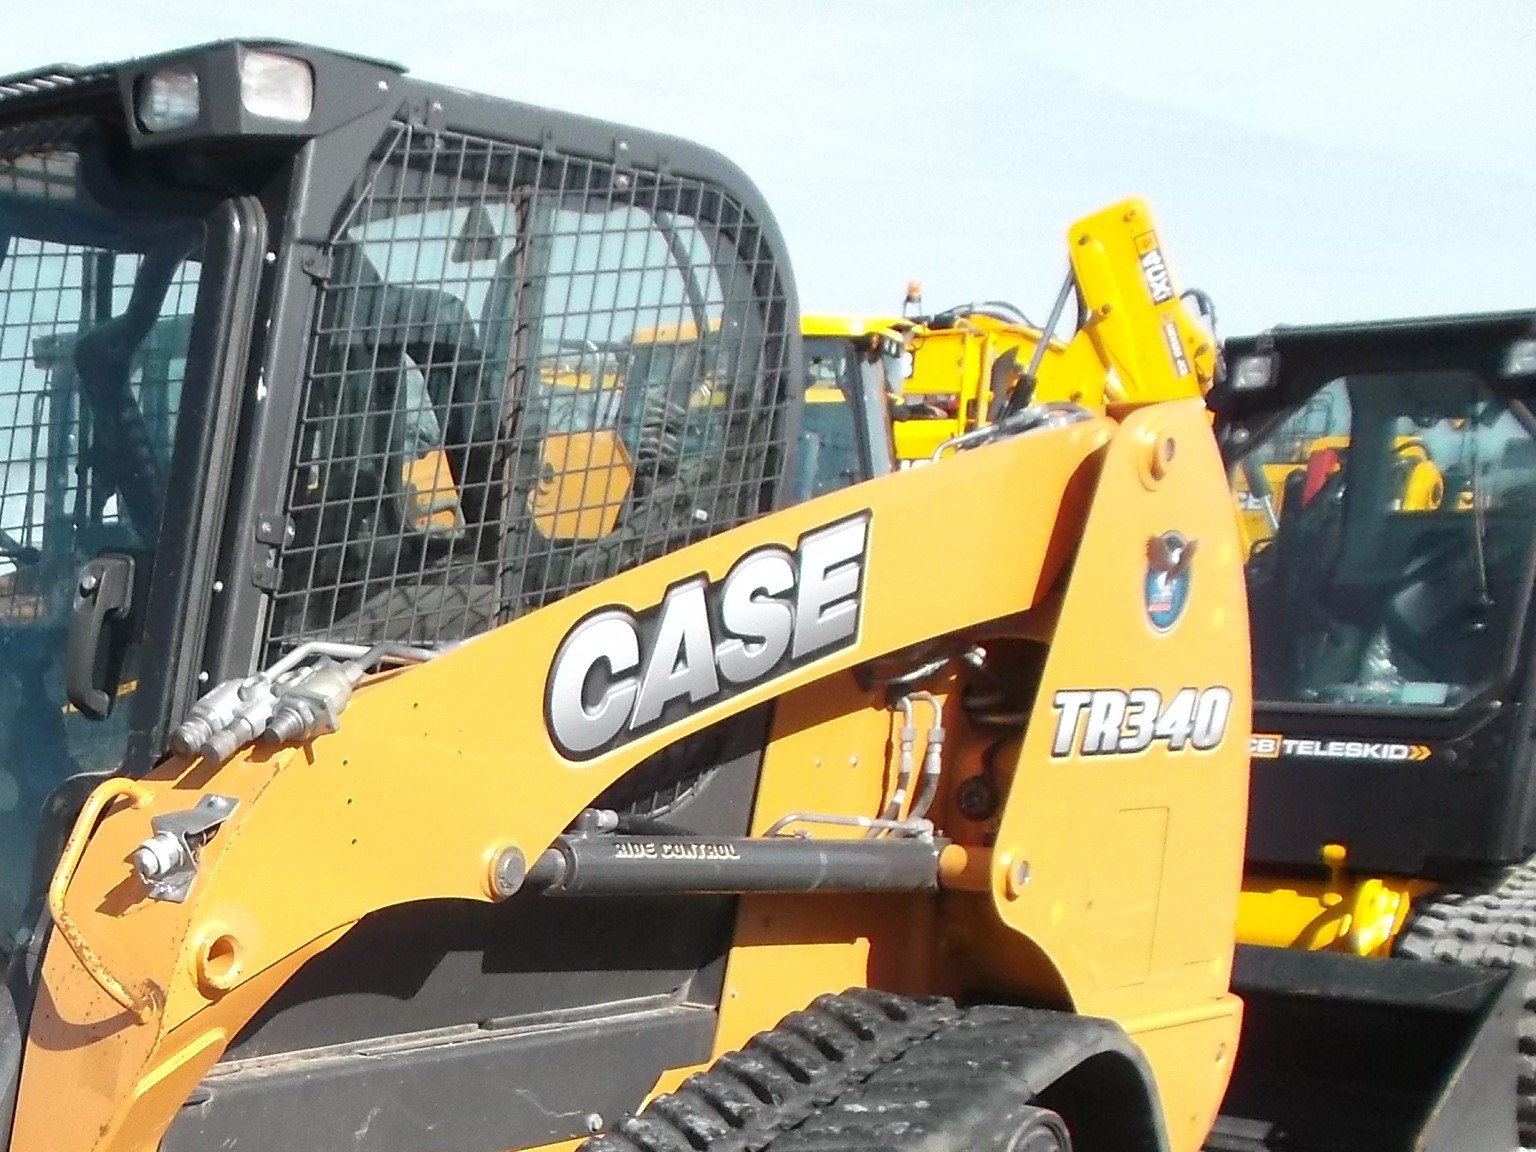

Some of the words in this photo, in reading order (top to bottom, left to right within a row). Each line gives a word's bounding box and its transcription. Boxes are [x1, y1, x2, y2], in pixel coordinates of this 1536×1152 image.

[546, 510, 870, 757] CASE
[1051, 686, 1232, 757] TR340
[1283, 739, 1408, 760] TELESKID
